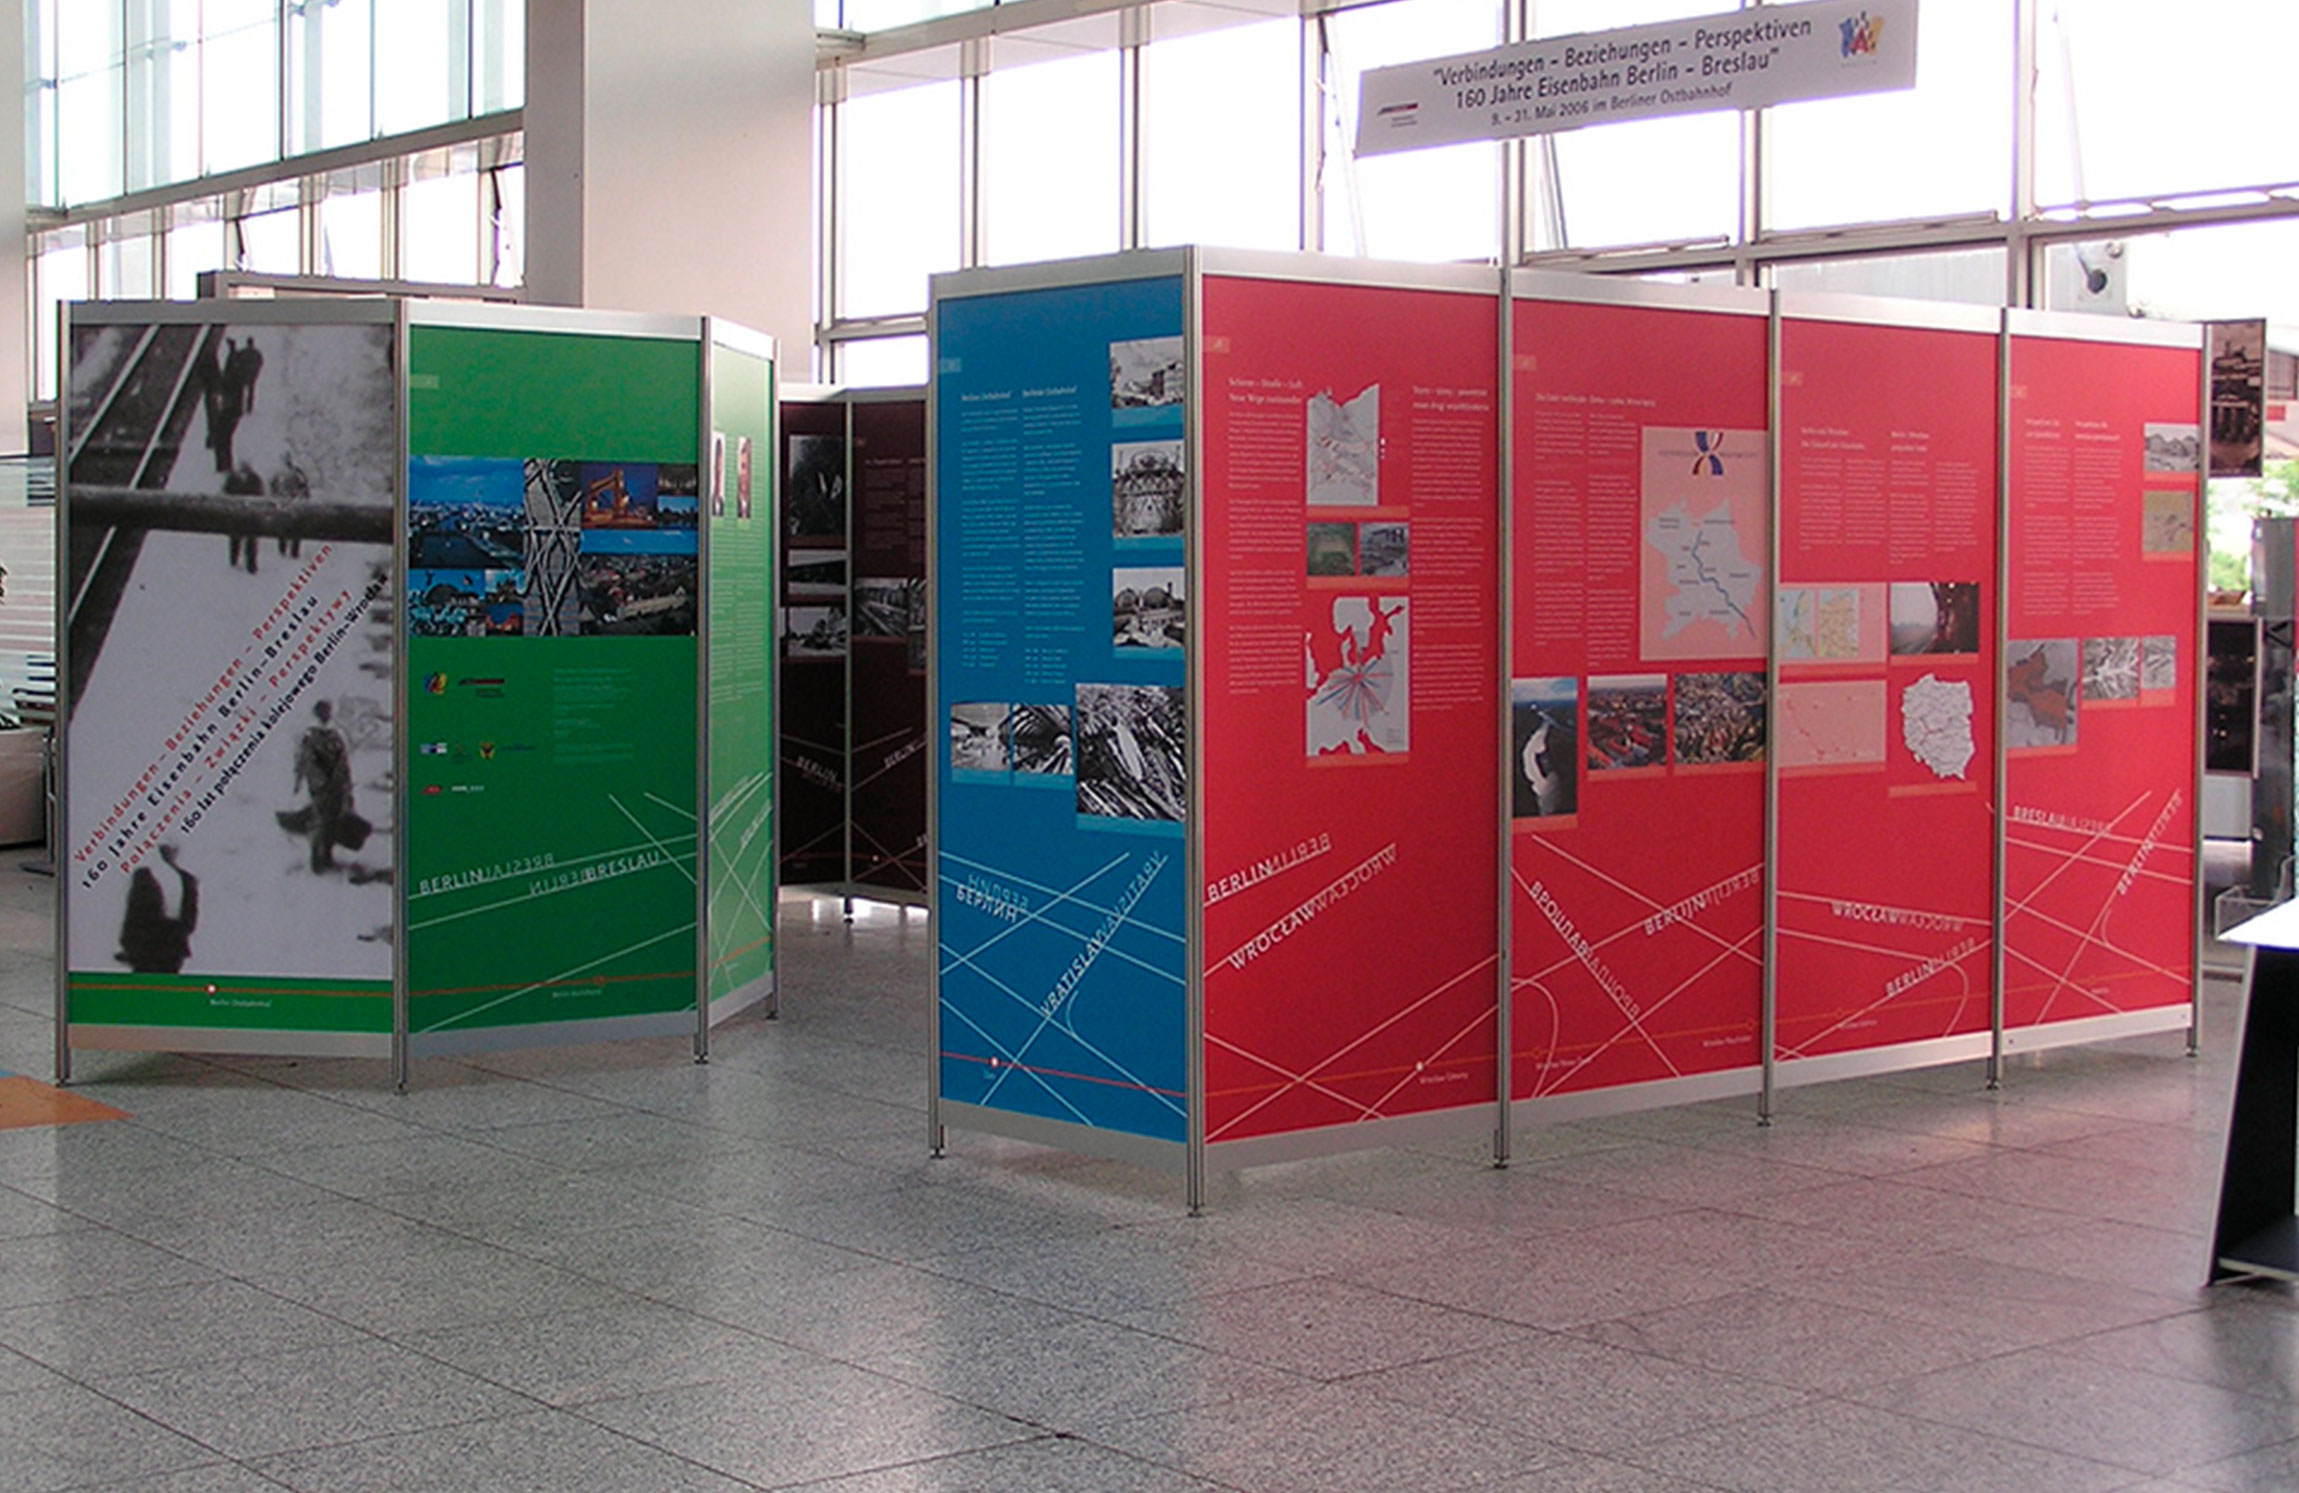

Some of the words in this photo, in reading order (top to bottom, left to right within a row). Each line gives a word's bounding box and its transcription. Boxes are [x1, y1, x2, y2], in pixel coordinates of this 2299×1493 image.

[1565, 38, 1671, 68] Beziehungen
[1694, 19, 1812, 50] Perspektiven
[1456, 88, 1486, 109] 160
[1490, 84, 1532, 105] Jahre
[1538, 69, 1620, 98] Eisenbahn
[1627, 63, 1677, 86] Berlin
[1535, 104, 1556, 120] Mai
[1559, 100, 1589, 117] 2006
[1593, 100, 1607, 112] im
[1611, 93, 1656, 111] Berliner
[269, 590, 351, 688] Perspektywy
[75, 764, 160, 862] Verbindungen
[165, 658, 243, 751] Beziehungen
[252, 545, 332, 641] Perspektiven
[82, 859, 109, 888] 160
[108, 811, 147, 857] Jahre
[147, 723, 218, 806] Eisenbahn
[197, 791, 217, 811] lat
[418, 868, 483, 896] BERLIN
[584, 851, 660, 883] BRESLAU
[1207, 858, 1272, 902] BERLIN
[1886, 959, 1935, 997] BERLIN
